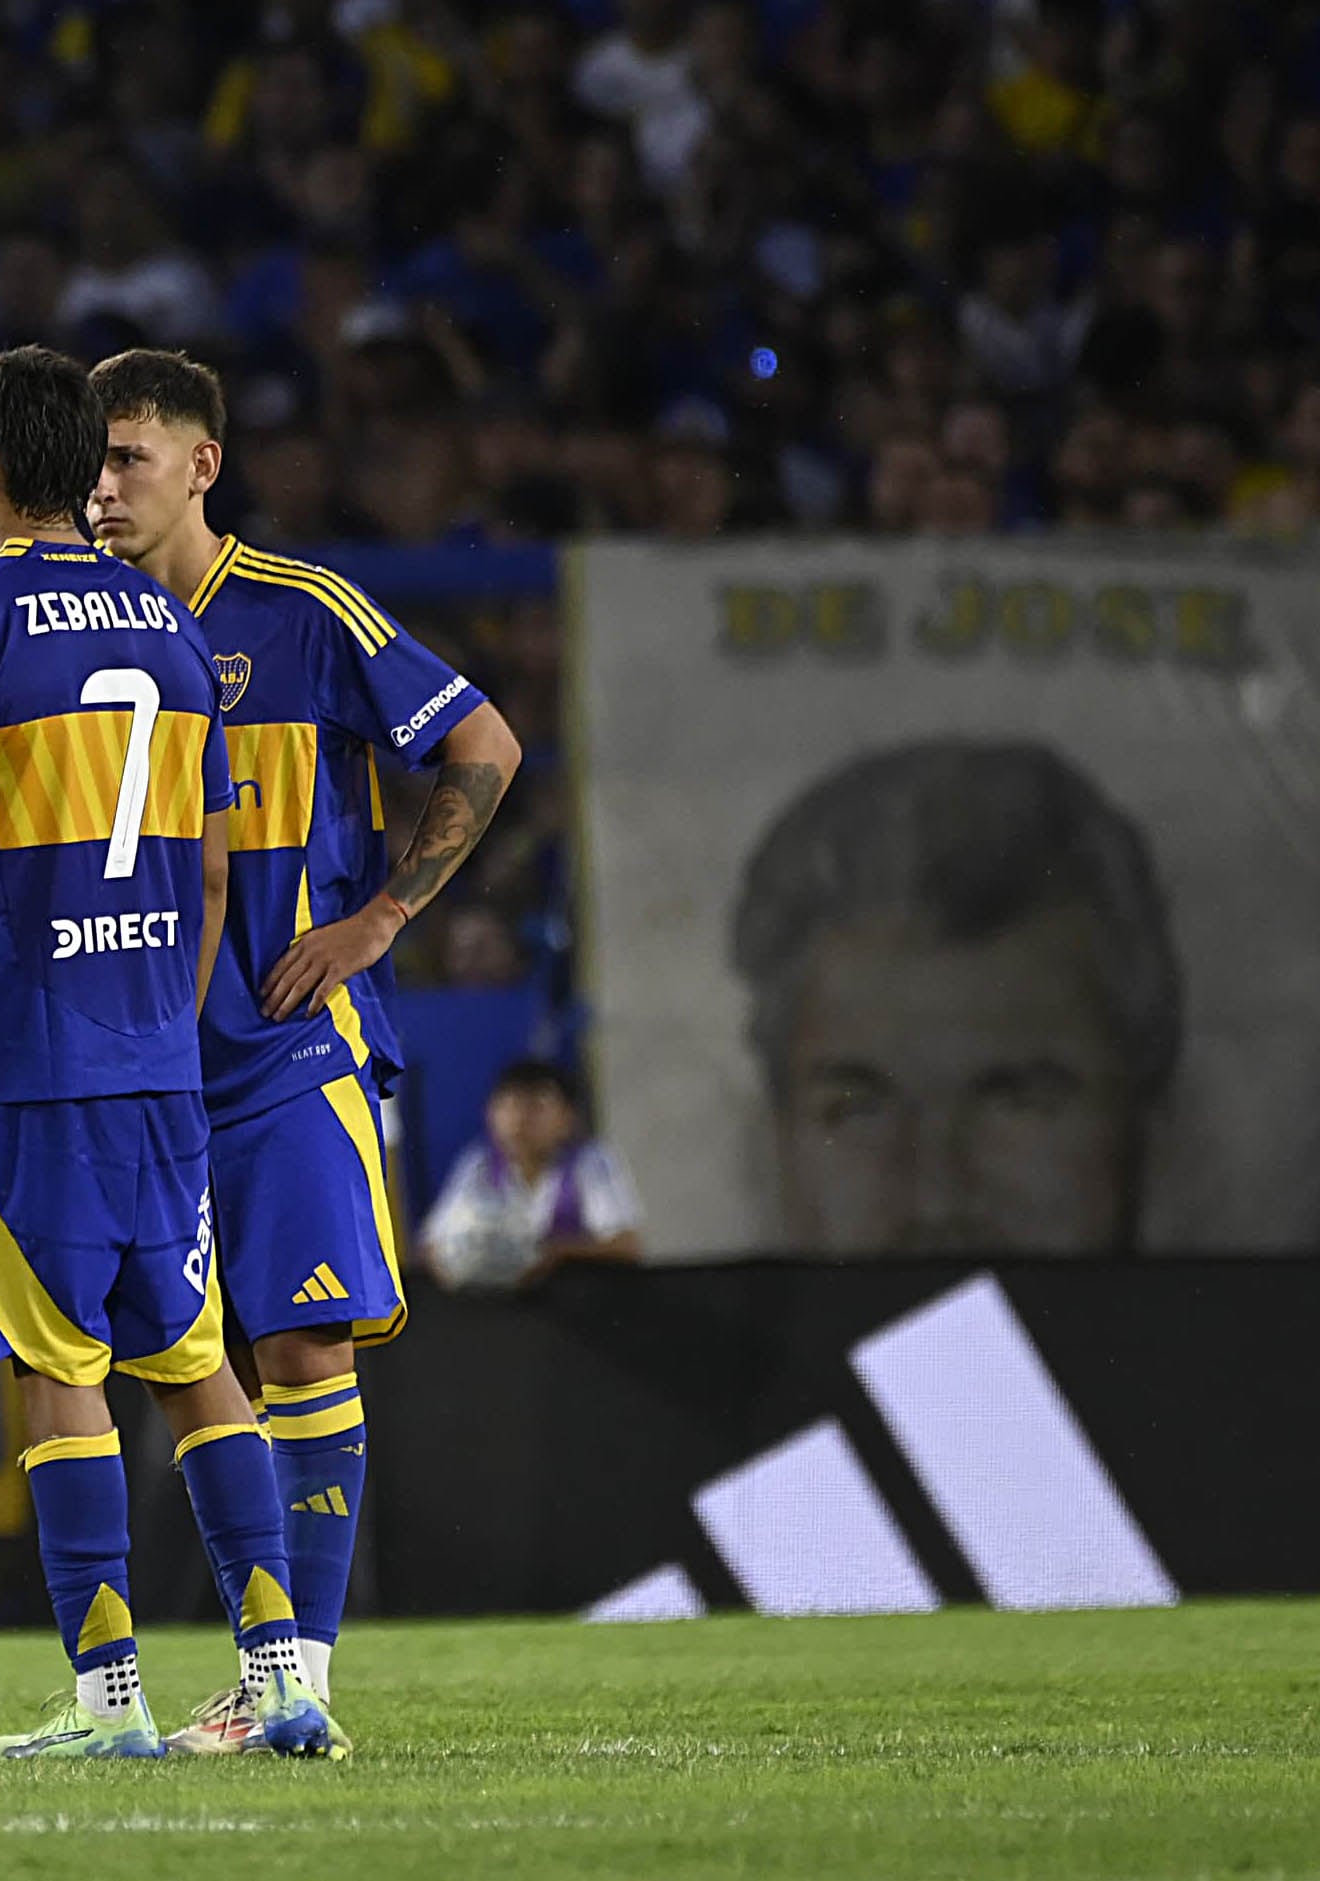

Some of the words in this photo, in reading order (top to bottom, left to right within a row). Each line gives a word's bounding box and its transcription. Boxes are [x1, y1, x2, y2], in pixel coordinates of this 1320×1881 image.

[15, 591, 178, 636] ZEBALLOS
[716, 578, 886, 658] DE
[80, 668, 160, 879] 7
[51, 911, 179, 959] DIRECT
